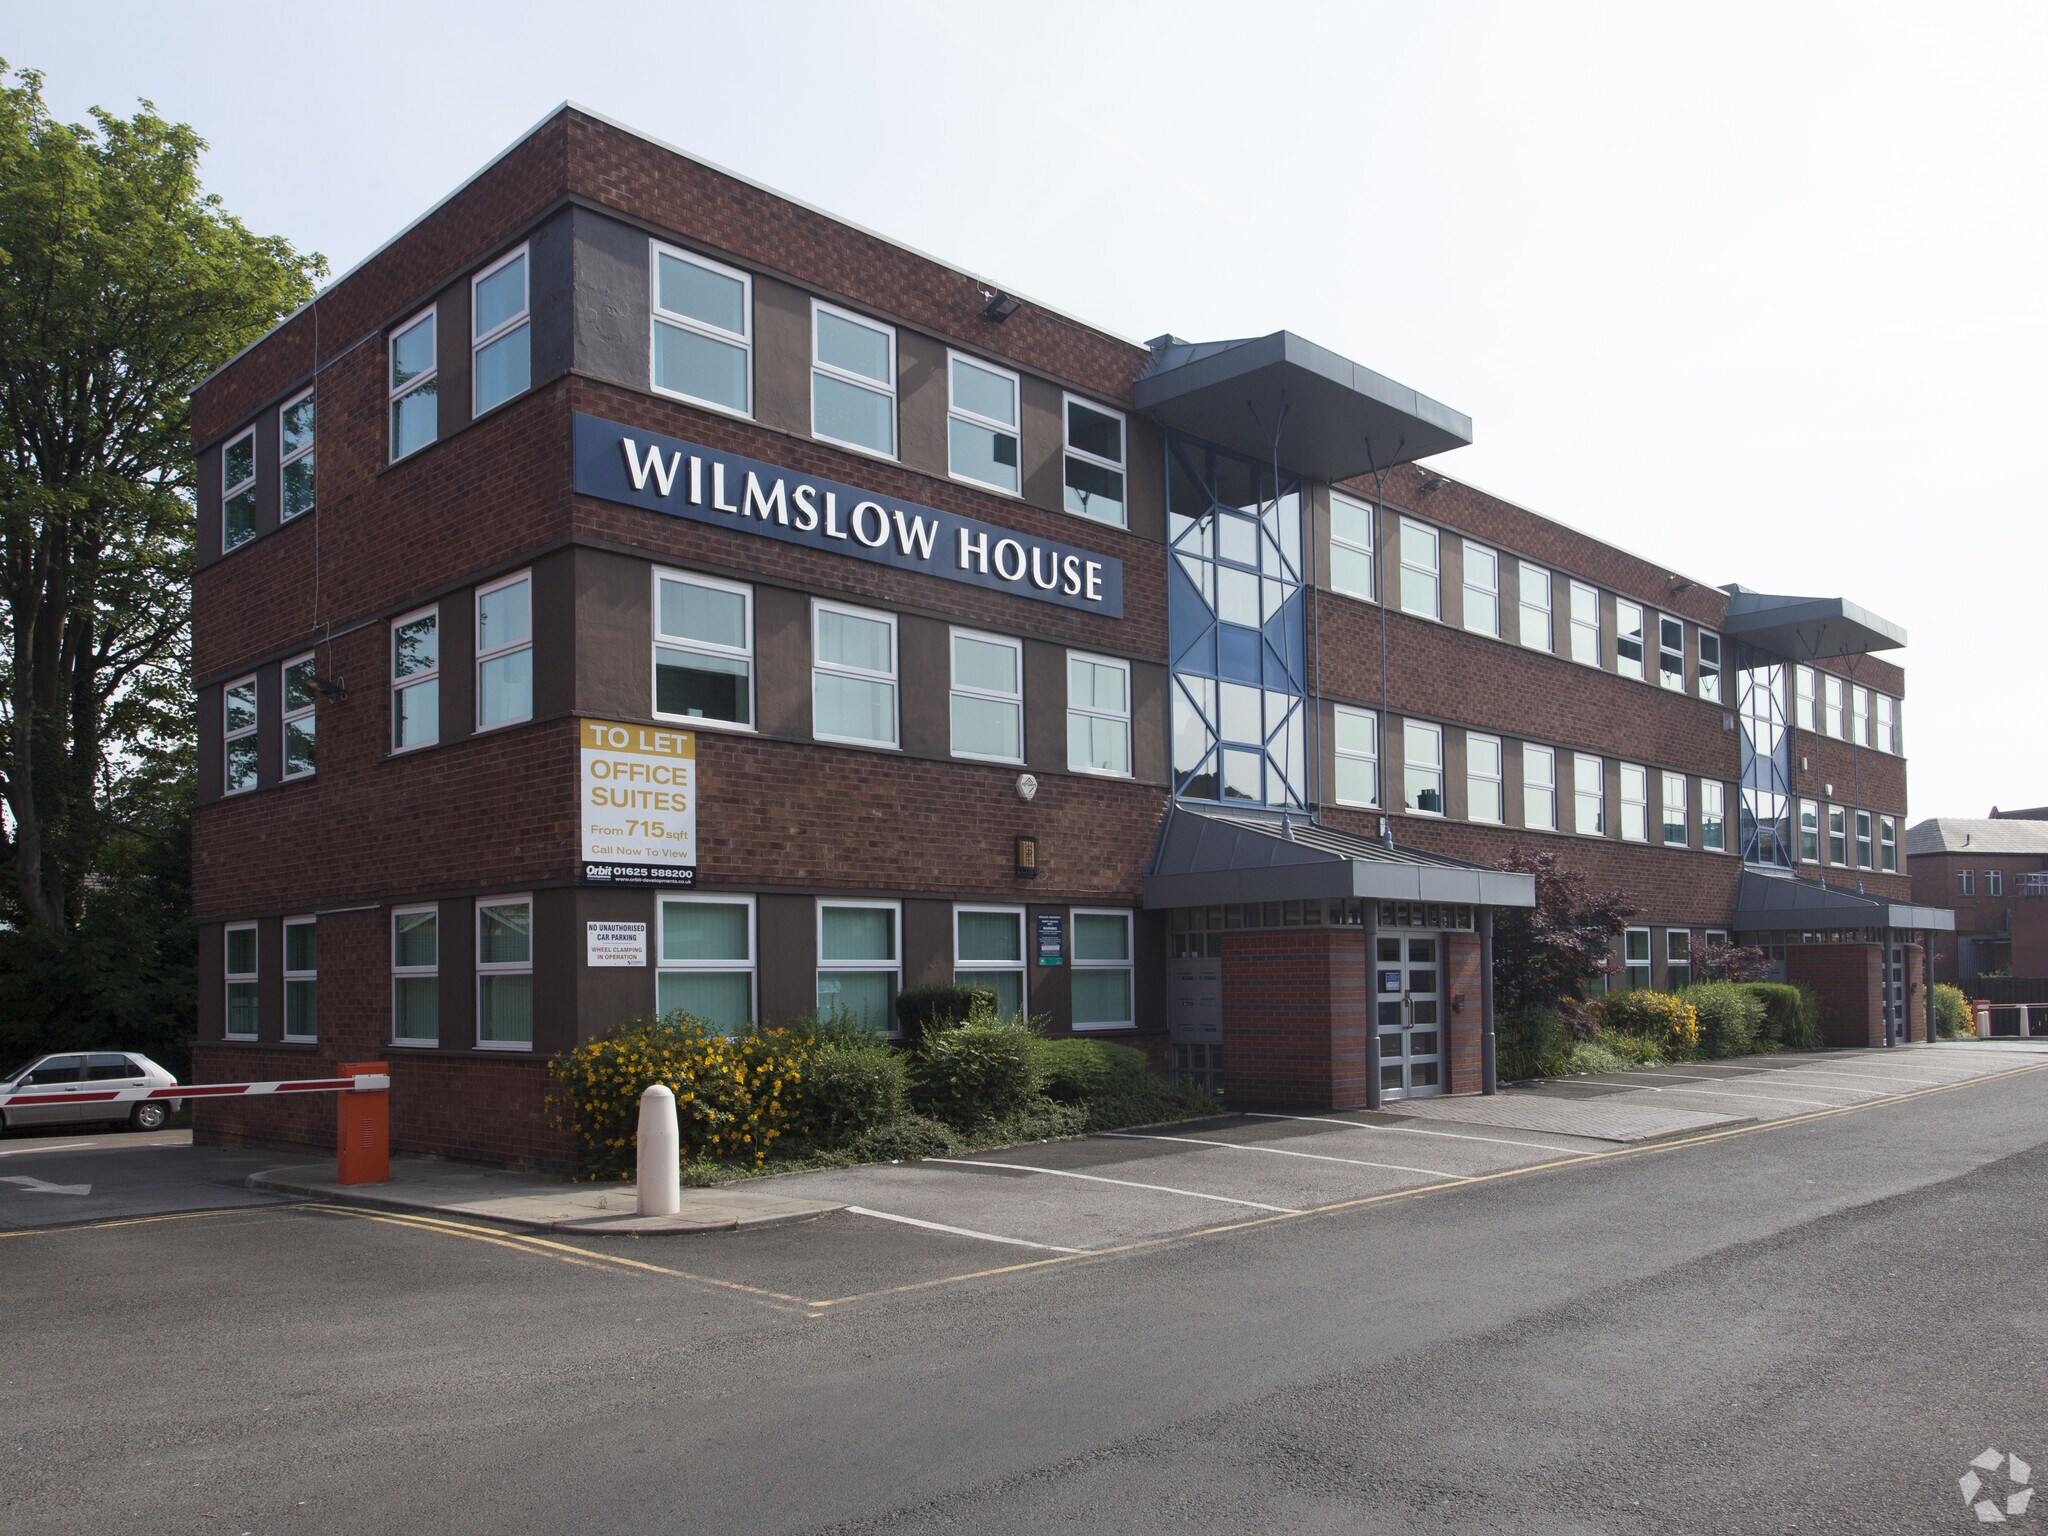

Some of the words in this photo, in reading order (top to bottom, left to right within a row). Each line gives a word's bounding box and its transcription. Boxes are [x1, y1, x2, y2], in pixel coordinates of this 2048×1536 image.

[623, 437, 939, 560] WILMSLOW
[957, 527, 1102, 600] HOUSE
[589, 724, 630, 748] TO
[639, 730, 688, 754] LET
[590, 759, 688, 787] OFFICE
[590, 786, 687, 813] SUITES
[591, 824, 624, 836] From
[591, 845, 613, 854] Call
[616, 846, 642, 856] Now
[644, 847, 660, 857] To
[661, 849, 688, 858] View
[586, 865, 612, 876] Orbit
[613, 867, 648, 876] 01625
[650, 868, 693, 879] 588200
[599, 924, 645, 932] UNAUTHORISED
